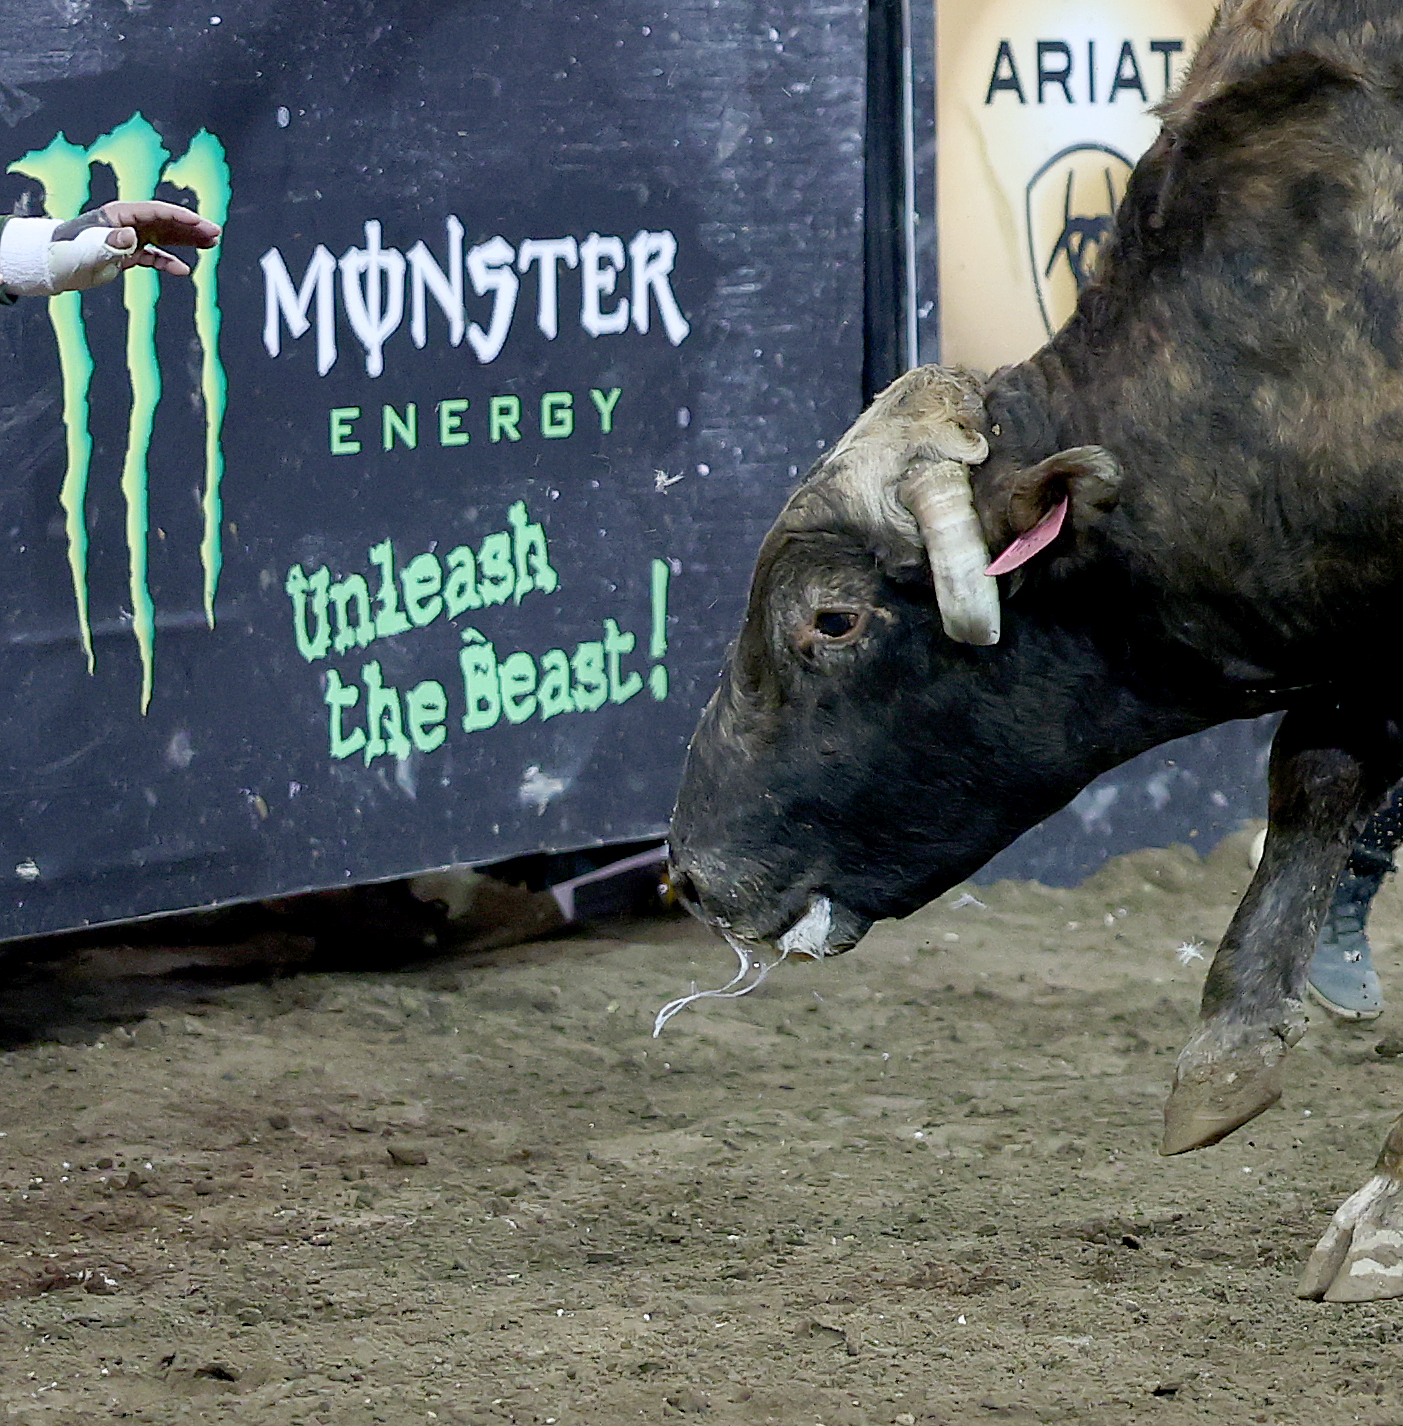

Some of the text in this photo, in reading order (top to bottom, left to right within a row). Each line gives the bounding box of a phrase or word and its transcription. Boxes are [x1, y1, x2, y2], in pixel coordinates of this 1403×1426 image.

[985, 40, 1184, 105] ARIAT
[259, 216, 691, 377] MONSTER
[328, 388, 624, 455] ENERGY
[286, 501, 559, 662] Unleash
[324, 558, 672, 766] the Beast!
